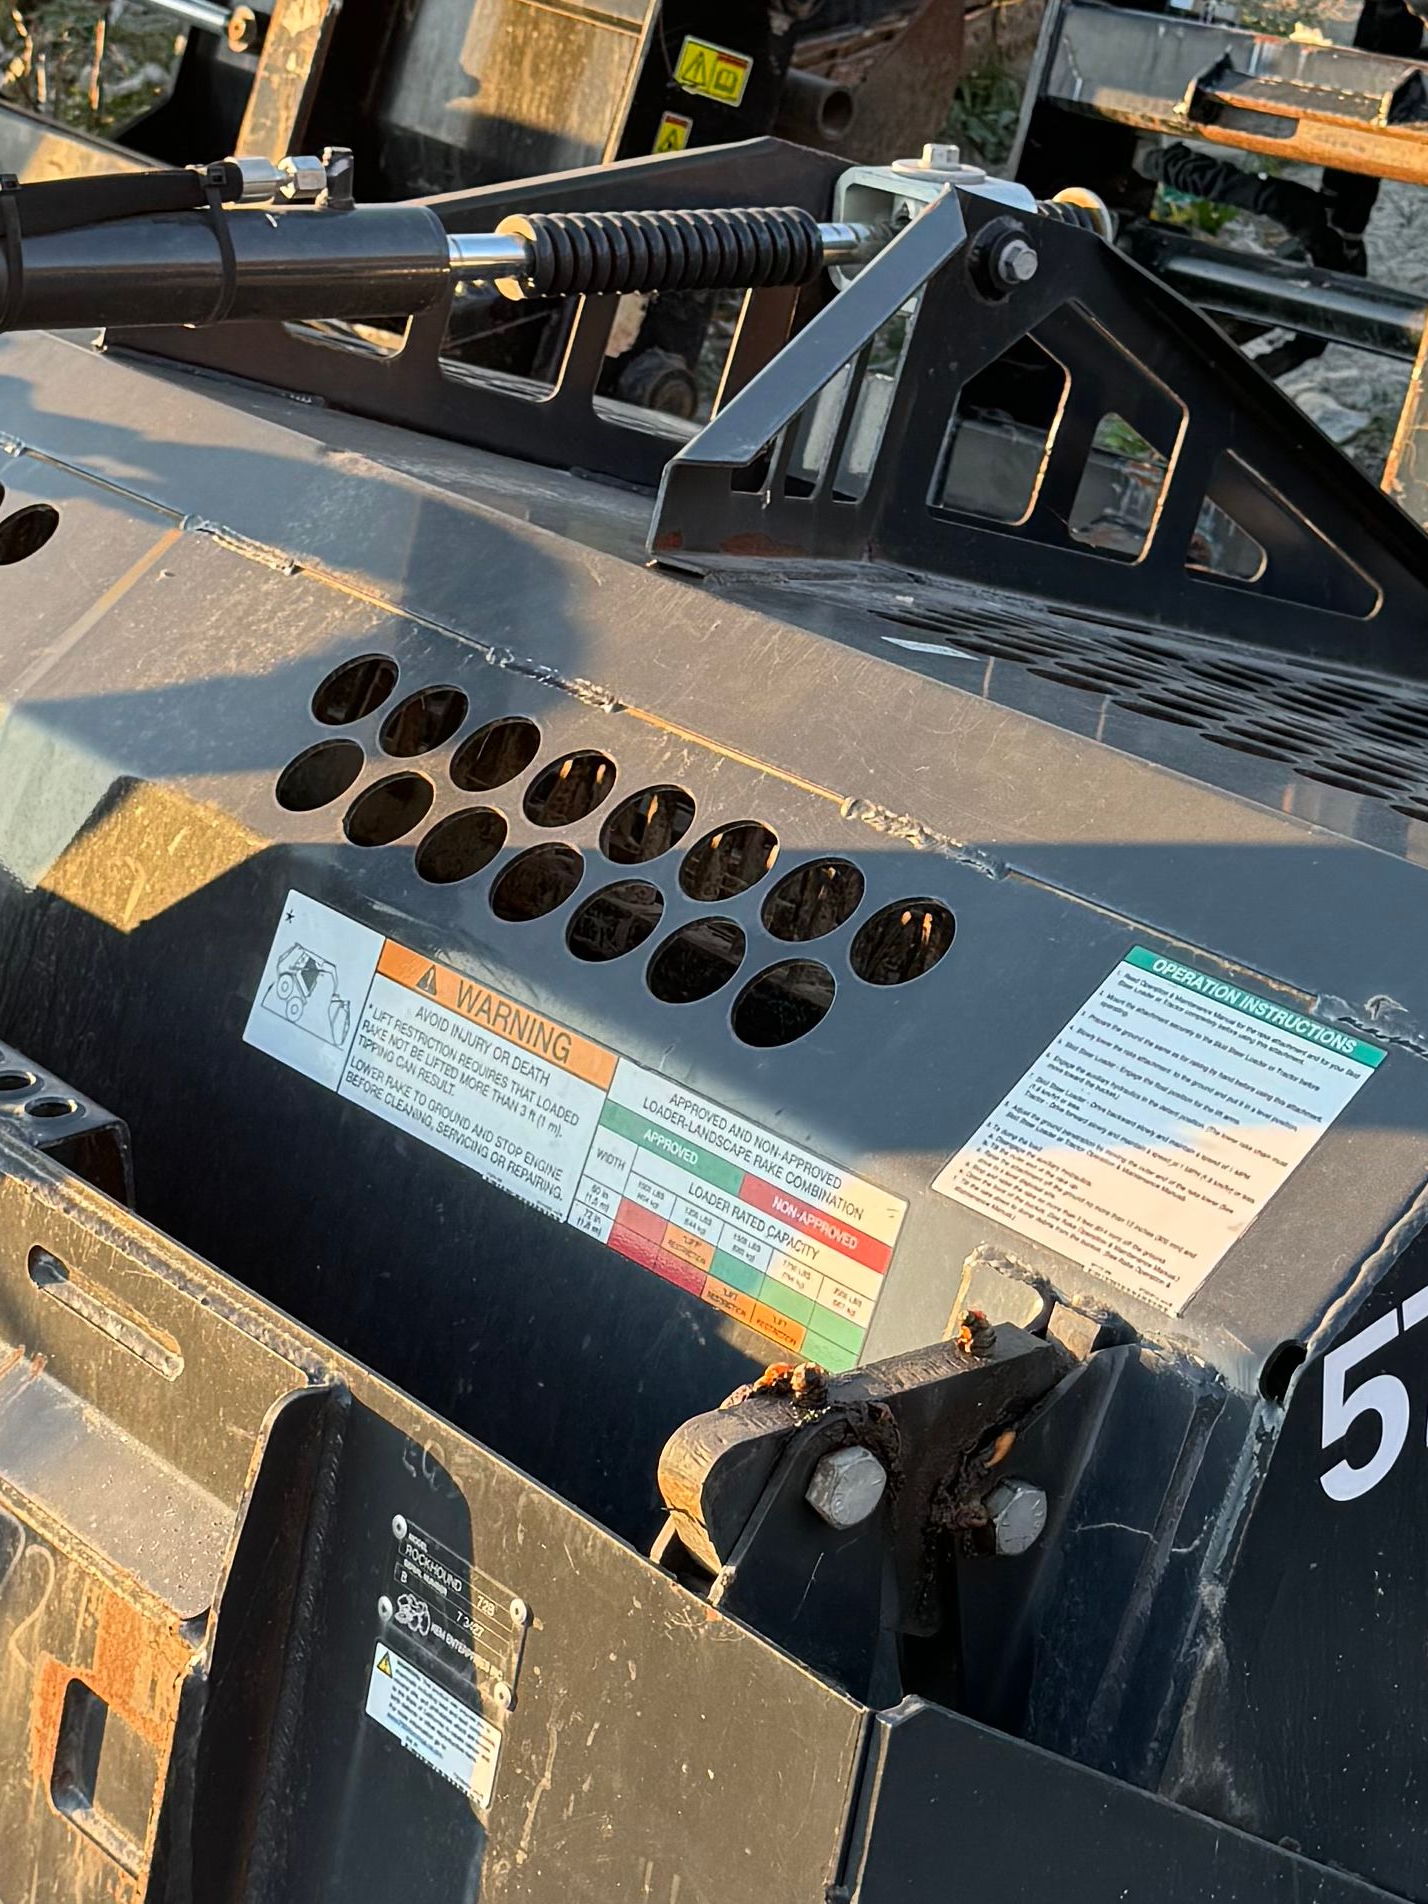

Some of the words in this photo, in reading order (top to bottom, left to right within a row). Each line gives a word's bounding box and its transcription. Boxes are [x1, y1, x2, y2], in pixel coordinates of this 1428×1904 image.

[414, 1004, 450, 1035] AVOID
[449, 1022, 491, 1056] INJURY
[491, 1045, 511, 1067] OR
[511, 1055, 551, 1087] DEATH
[451, 979, 575, 1064] WARNING
[1149, 956, 1243, 1004] OPERATION
[1237, 994, 1359, 1055] INSTRUCTIONS
[355, 1034, 395, 1064] TIPPING
[394, 1054, 417, 1076] CAN
[416, 1066, 456, 1097] RESULT.
[360, 1019, 387, 1042] RAKE
[387, 1033, 410, 1055] NOT
[409, 1045, 425, 1063] BE
[424, 1053, 459, 1081] LIFTED
[458, 1071, 490, 1099] MORE
[489, 1088, 519, 1115] THAN
[518, 1103, 528, 1119] 3
[371, 1006, 393, 1027] LIFT
[392, 1017, 458, 1061] RESTRICTION
[457, 1052, 509, 1089] REQUIRES
[509, 1079, 535, 1104] THAT
[535, 1093, 580, 1128] LOADED
[344, 1070, 384, 1101] BEFORE
[383, 1091, 437, 1130] CLEANING,
[435, 1120, 489, 1160] SERVICING
[489, 1150, 506, 1170] OR
[506, 1160, 565, 1202] REPAIRING.
[349, 1054, 385, 1083] LOWER
[384, 1074, 412, 1098] RAKE
[412, 1089, 427, 1107] TO
[427, 1098, 471, 1131] GROUND
[471, 1122, 494, 1144] AND
[493, 1134, 523, 1160] STOP
[523, 1151, 563, 1182] ENGINE
[595, 1147, 626, 1172] WIDTH
[641, 1096, 752, 1163] LOADER-LANDSCAPE
[752, 1153, 784, 1180] RAKE
[784, 1170, 864, 1222] COMBINATION
[642, 1127, 699, 1166] APPROVED
[669, 1092, 728, 1131] APPROVED
[727, 1121, 753, 1144] AND
[753, 1135, 843, 1191] NON-APPROVED
[688, 1182, 731, 1214] LOADER
[730, 1204, 766, 1233] RATED
[765, 1223, 820, 1262] CAPACITY
[771, 1195, 859, 1251] NON-APPROVED
[404, 1543, 463, 1591] ROCKHOUND
